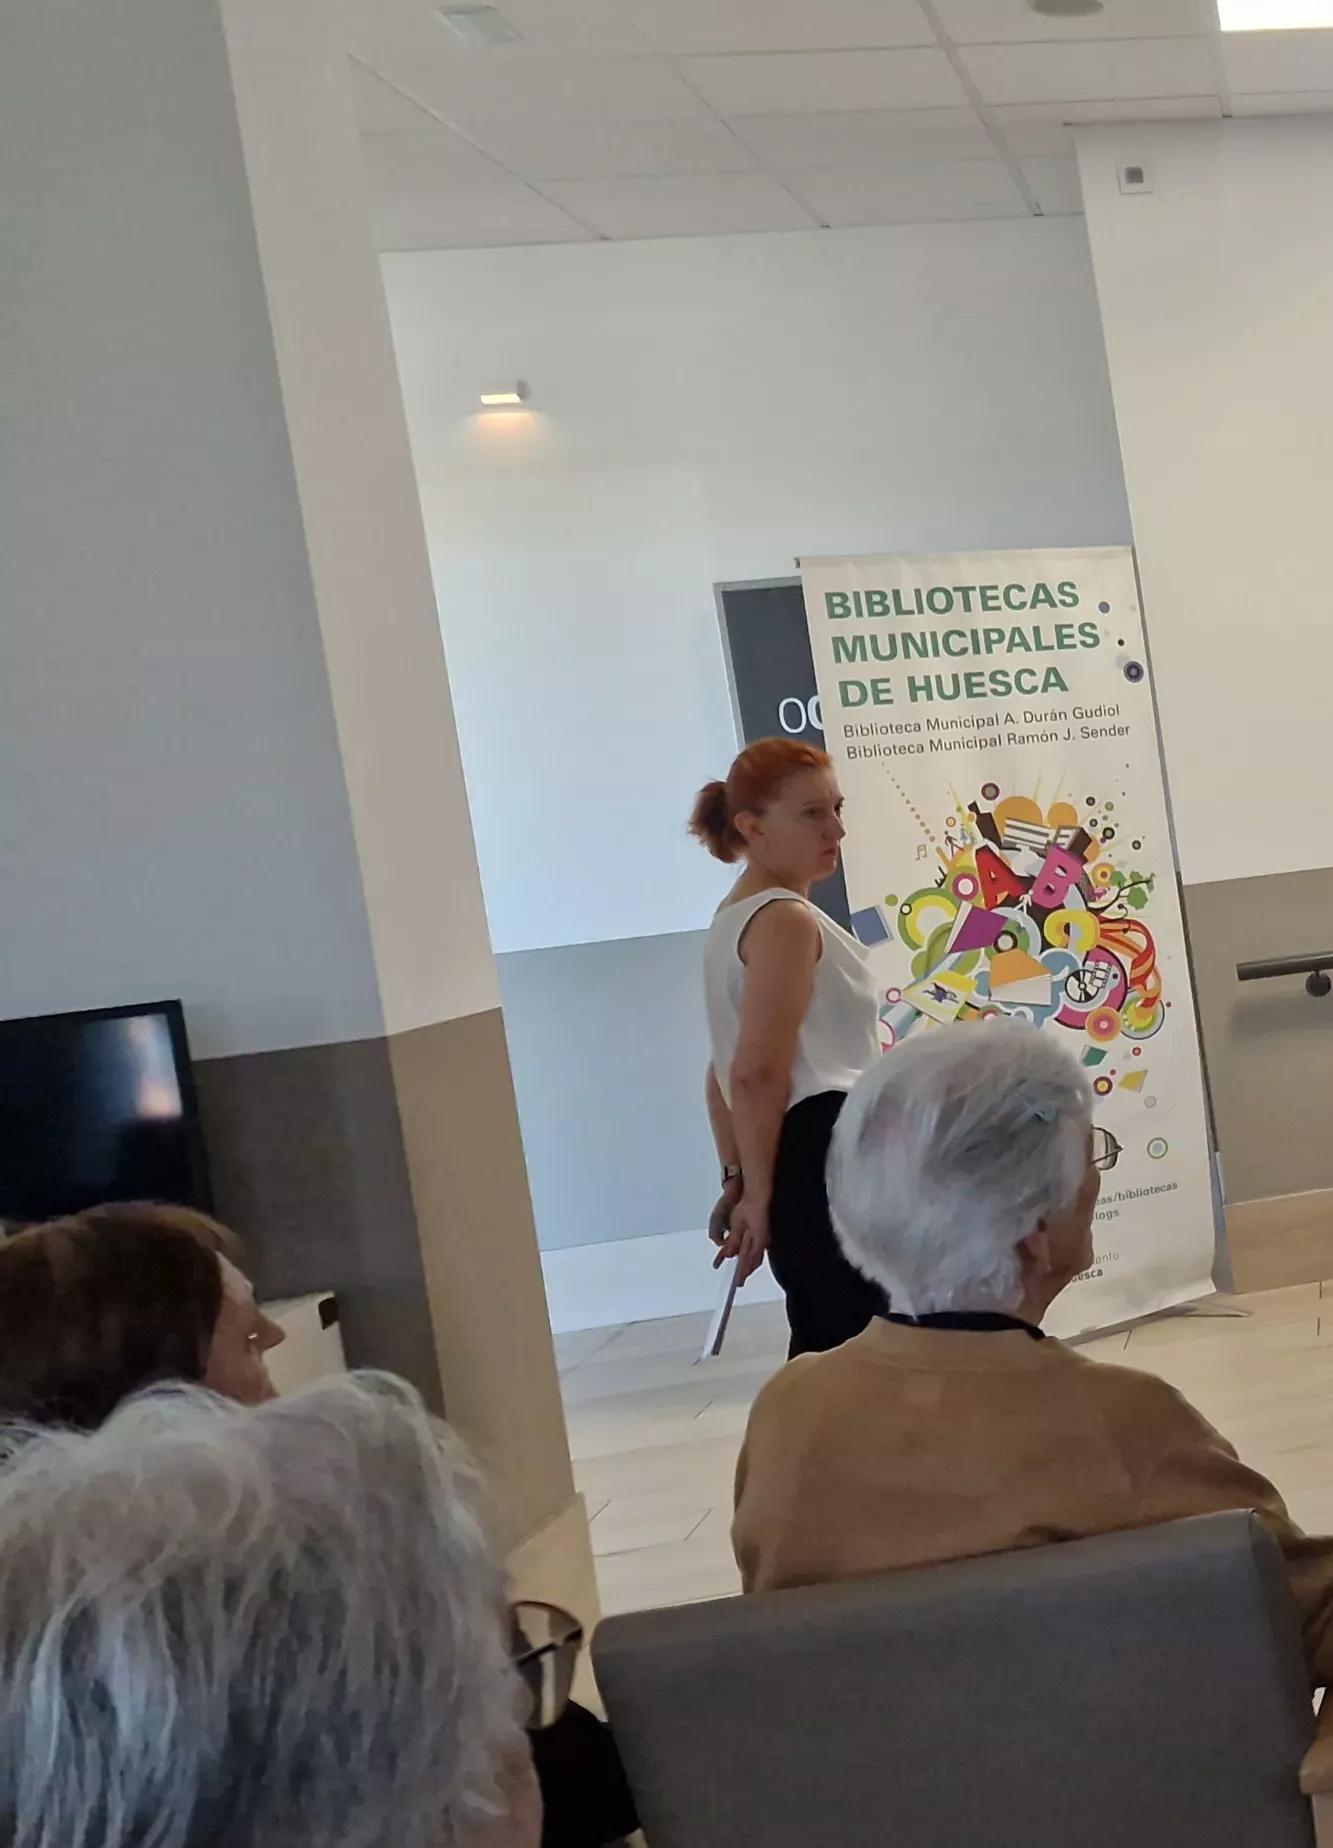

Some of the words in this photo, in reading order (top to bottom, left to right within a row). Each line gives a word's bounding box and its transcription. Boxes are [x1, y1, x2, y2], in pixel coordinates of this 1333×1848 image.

[824, 581, 1080, 620] BIBLIOTECAS
[831, 622, 1101, 664] MUNICIPALES
[838, 677, 895, 708] DE
[906, 666, 1069, 703] HUESCA
[778, 695, 824, 734] 00
[843, 717, 922, 739] Biblioteca
[926, 713, 1000, 733] Municipal
[1004, 712, 1020, 725] A.
[1023, 708, 1068, 725] Durán
[1072, 704, 1120, 720] Gudiol
[846, 739, 925, 760] Biblioteca
[929, 734, 1002, 754] Municipal
[1007, 728, 1059, 746] Ramón
[1063, 727, 1076, 741] J.
[1080, 723, 1131, 740] Sender
[1095, 1181, 1178, 1206] as/bibliotecas
[1093, 1208, 1120, 1221] logs
[1071, 1268, 1103, 1283] uesca
